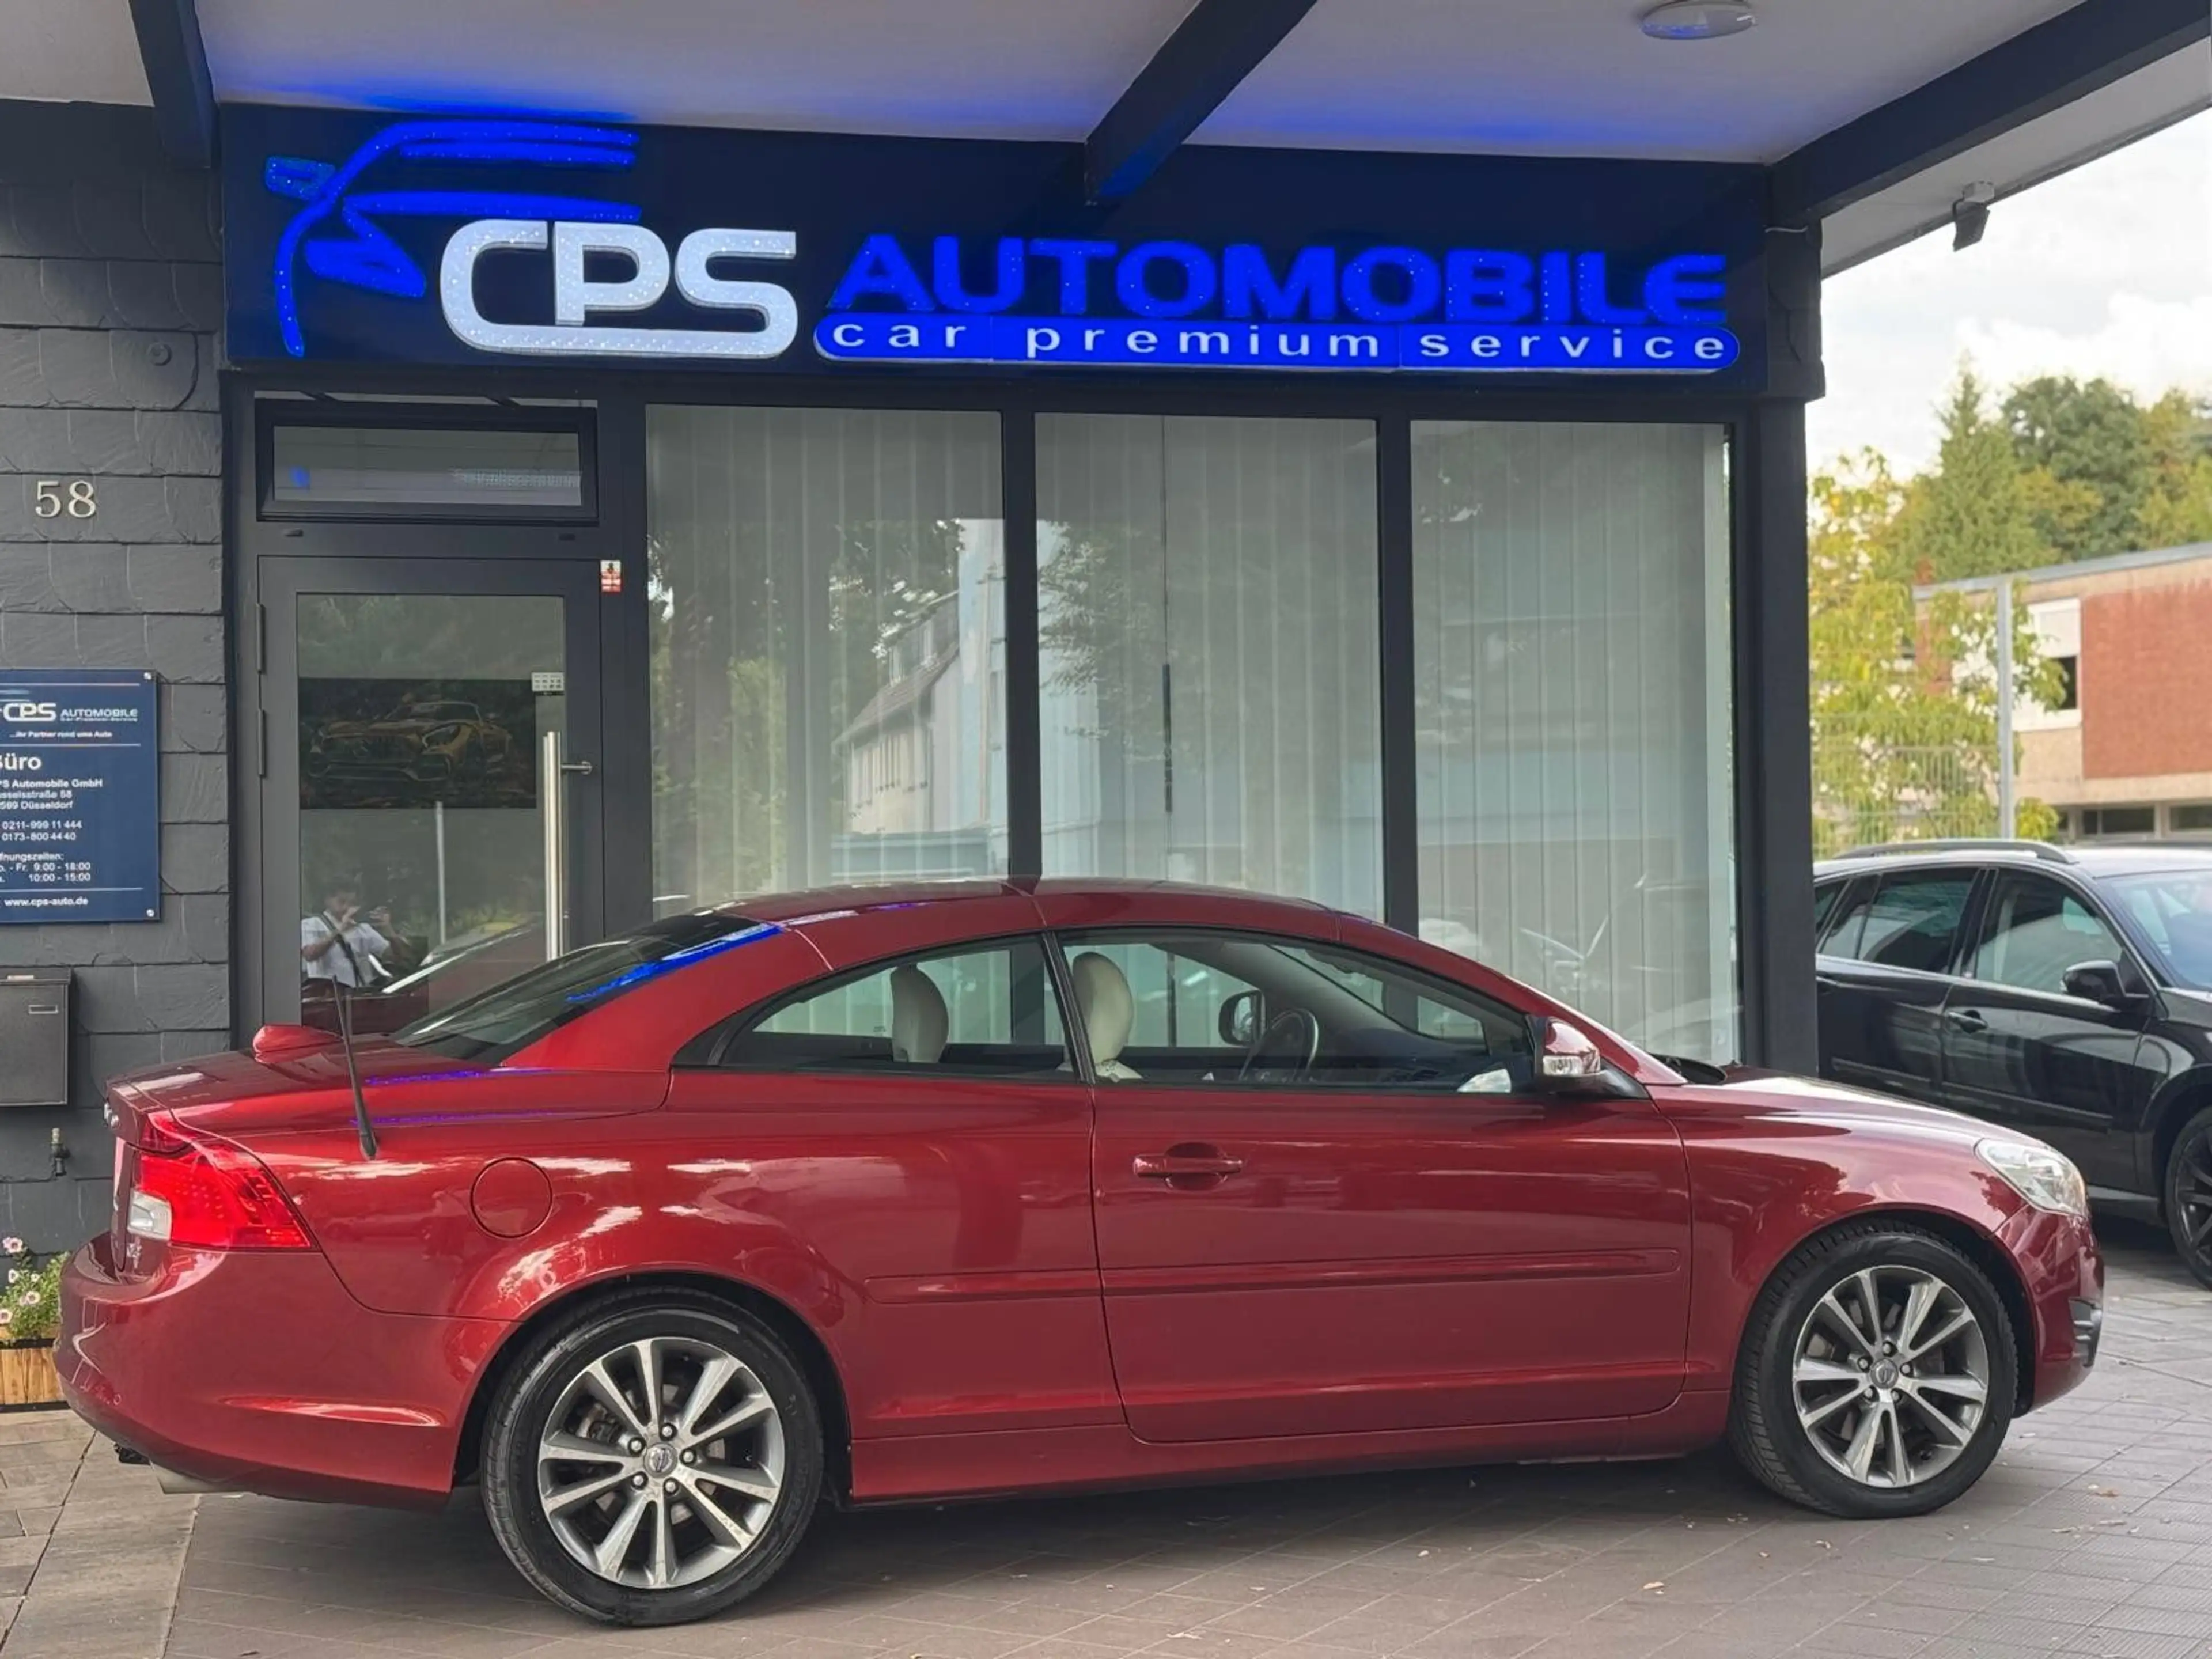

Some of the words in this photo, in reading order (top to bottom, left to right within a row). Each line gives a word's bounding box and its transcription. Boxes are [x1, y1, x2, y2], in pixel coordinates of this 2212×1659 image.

[441, 219, 798, 359] CPS
[825, 233, 1727, 324] AUTOMOBILE
[832, 323, 966, 348] car
[1027, 325, 1379, 358] premium
[1420, 329, 1725, 360] service
[35, 480, 96, 518] 58
[3, 702, 56, 722] CPS
[60, 708, 138, 717] AUTOMOBILE
[0, 753, 42, 770] üro
[12, 779, 69, 788] Automobile
[71, 778, 103, 787] GmbH
[20, 800, 73, 809] Düsseldorf
[63, 820, 82, 829] 444
[4, 897, 89, 908] www.cps-auto.de
